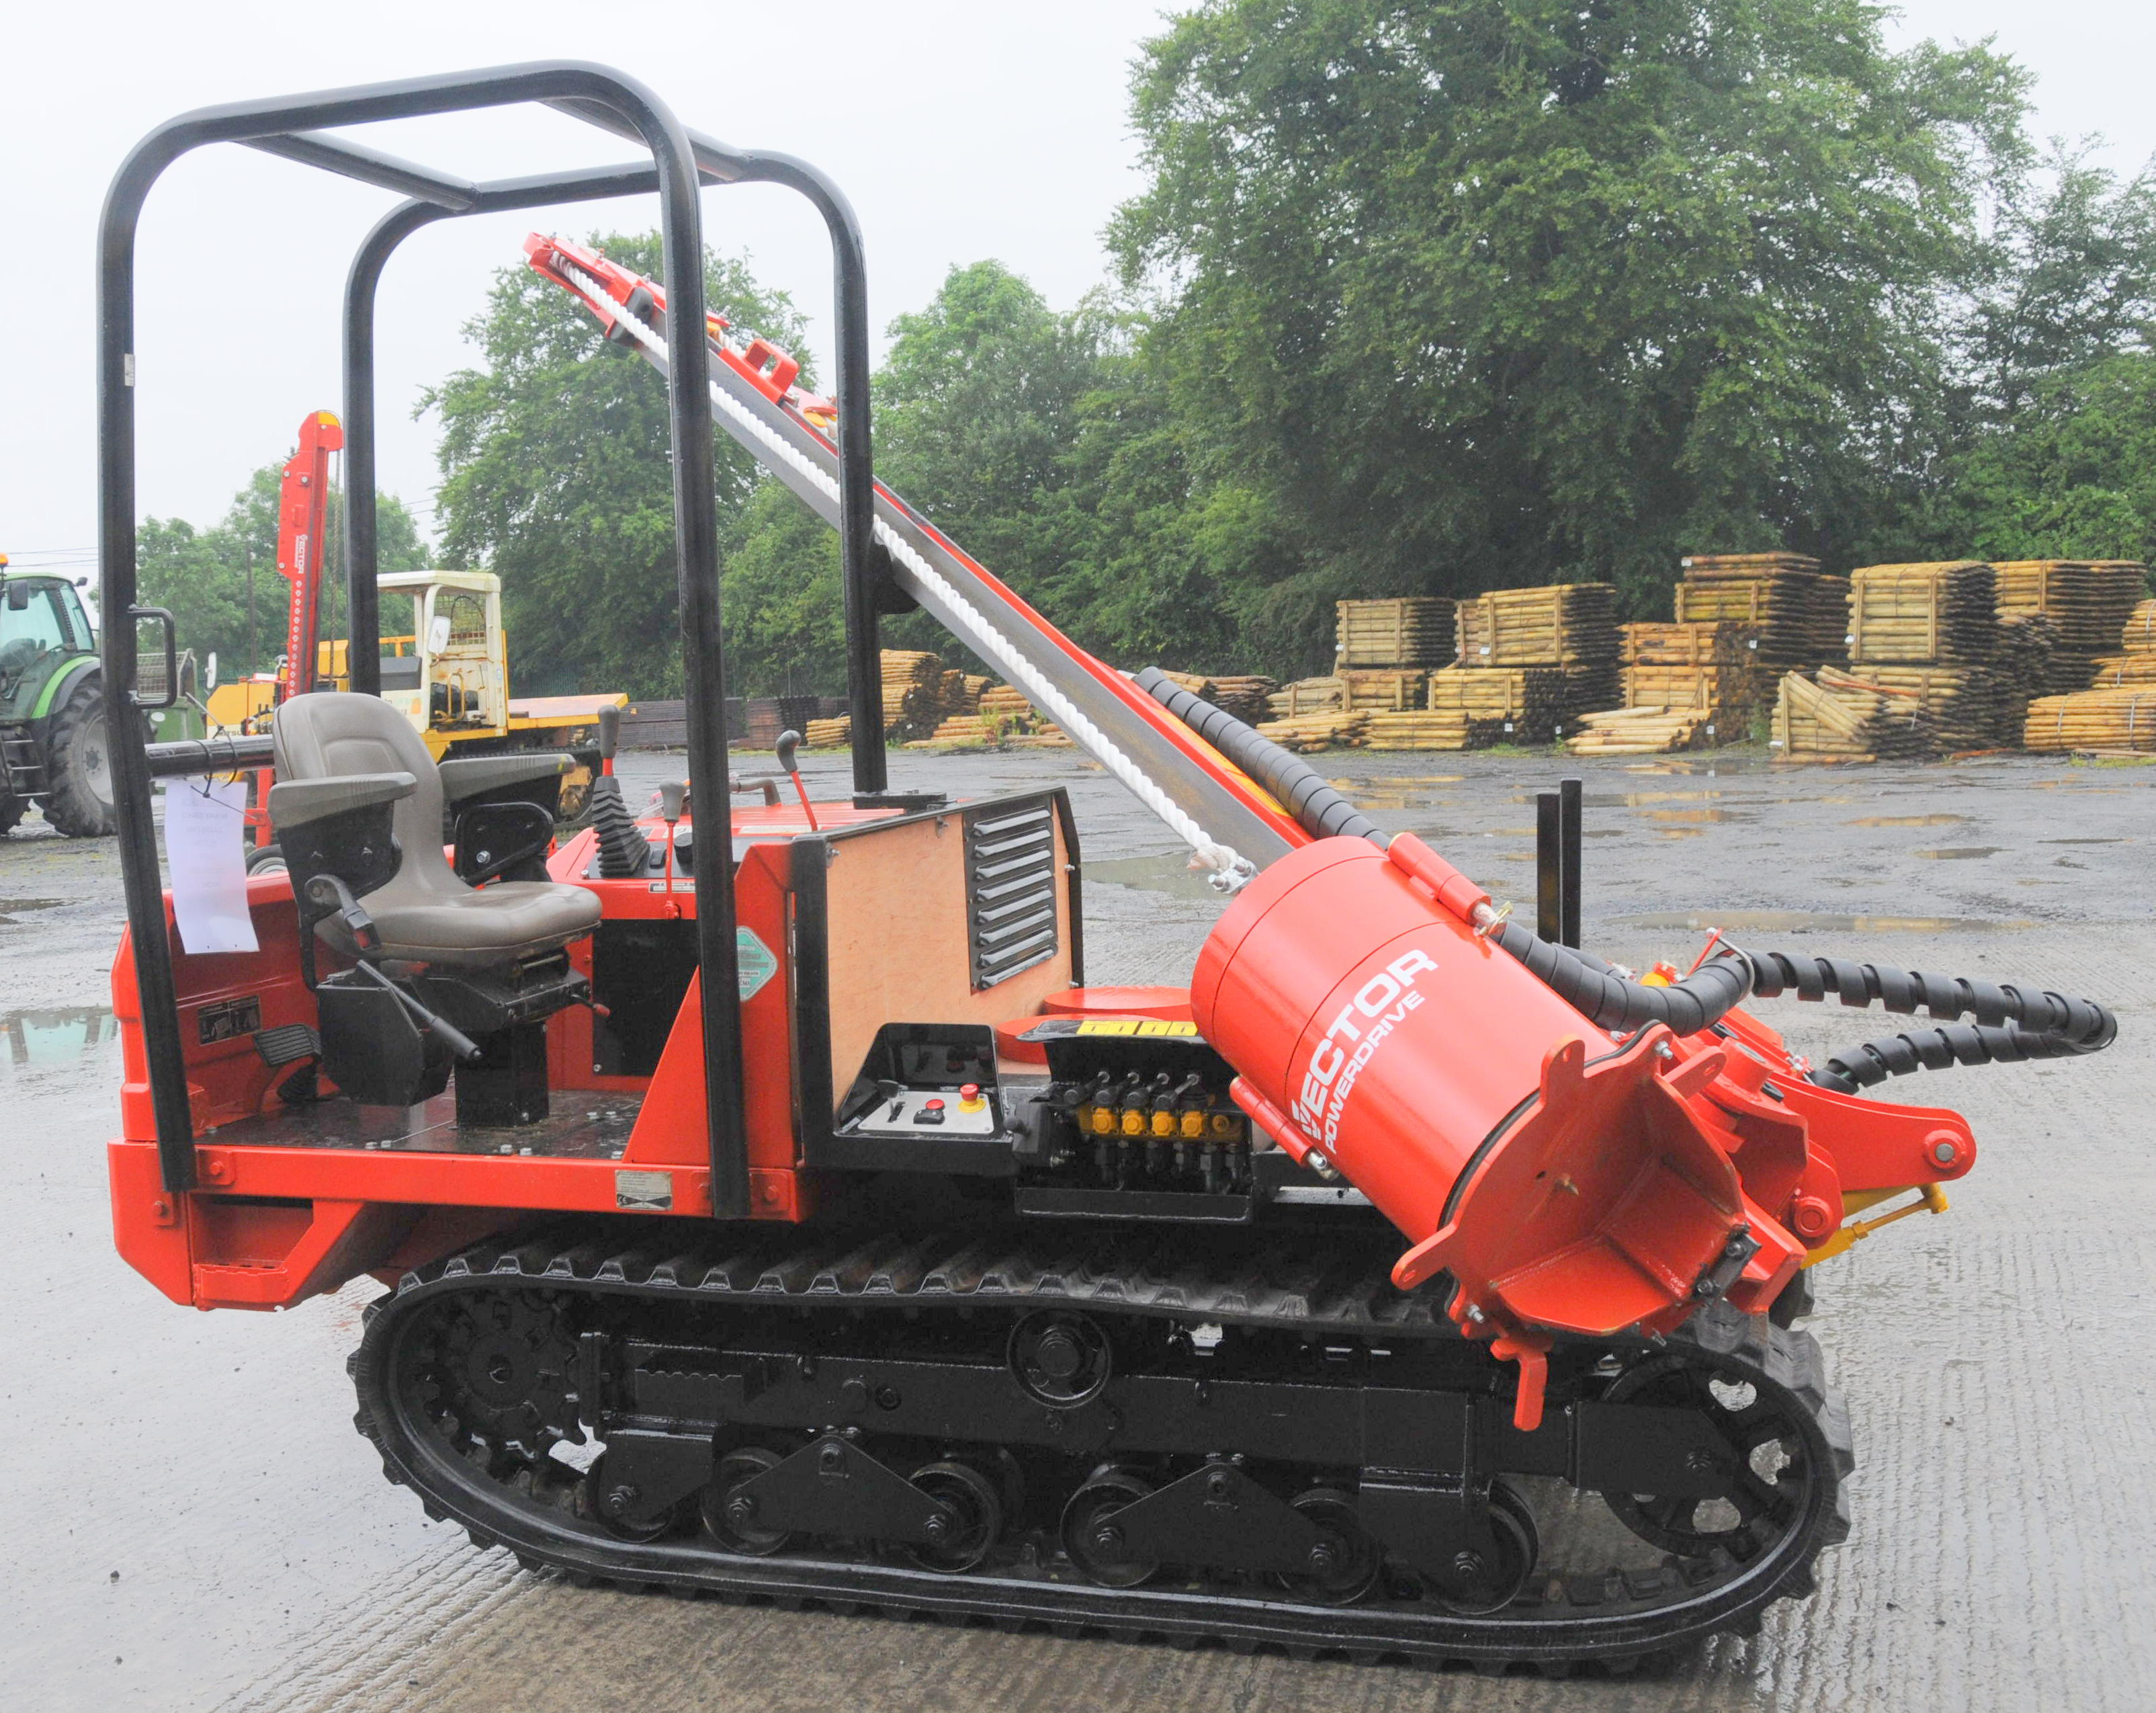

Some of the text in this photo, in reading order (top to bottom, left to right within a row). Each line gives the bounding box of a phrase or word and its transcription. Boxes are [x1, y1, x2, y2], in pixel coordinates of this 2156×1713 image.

[298, 534, 308, 574] VECTOR
[1291, 949, 1439, 1141] VECTOR
[1325, 990, 1426, 1155] POWERDRIVE
